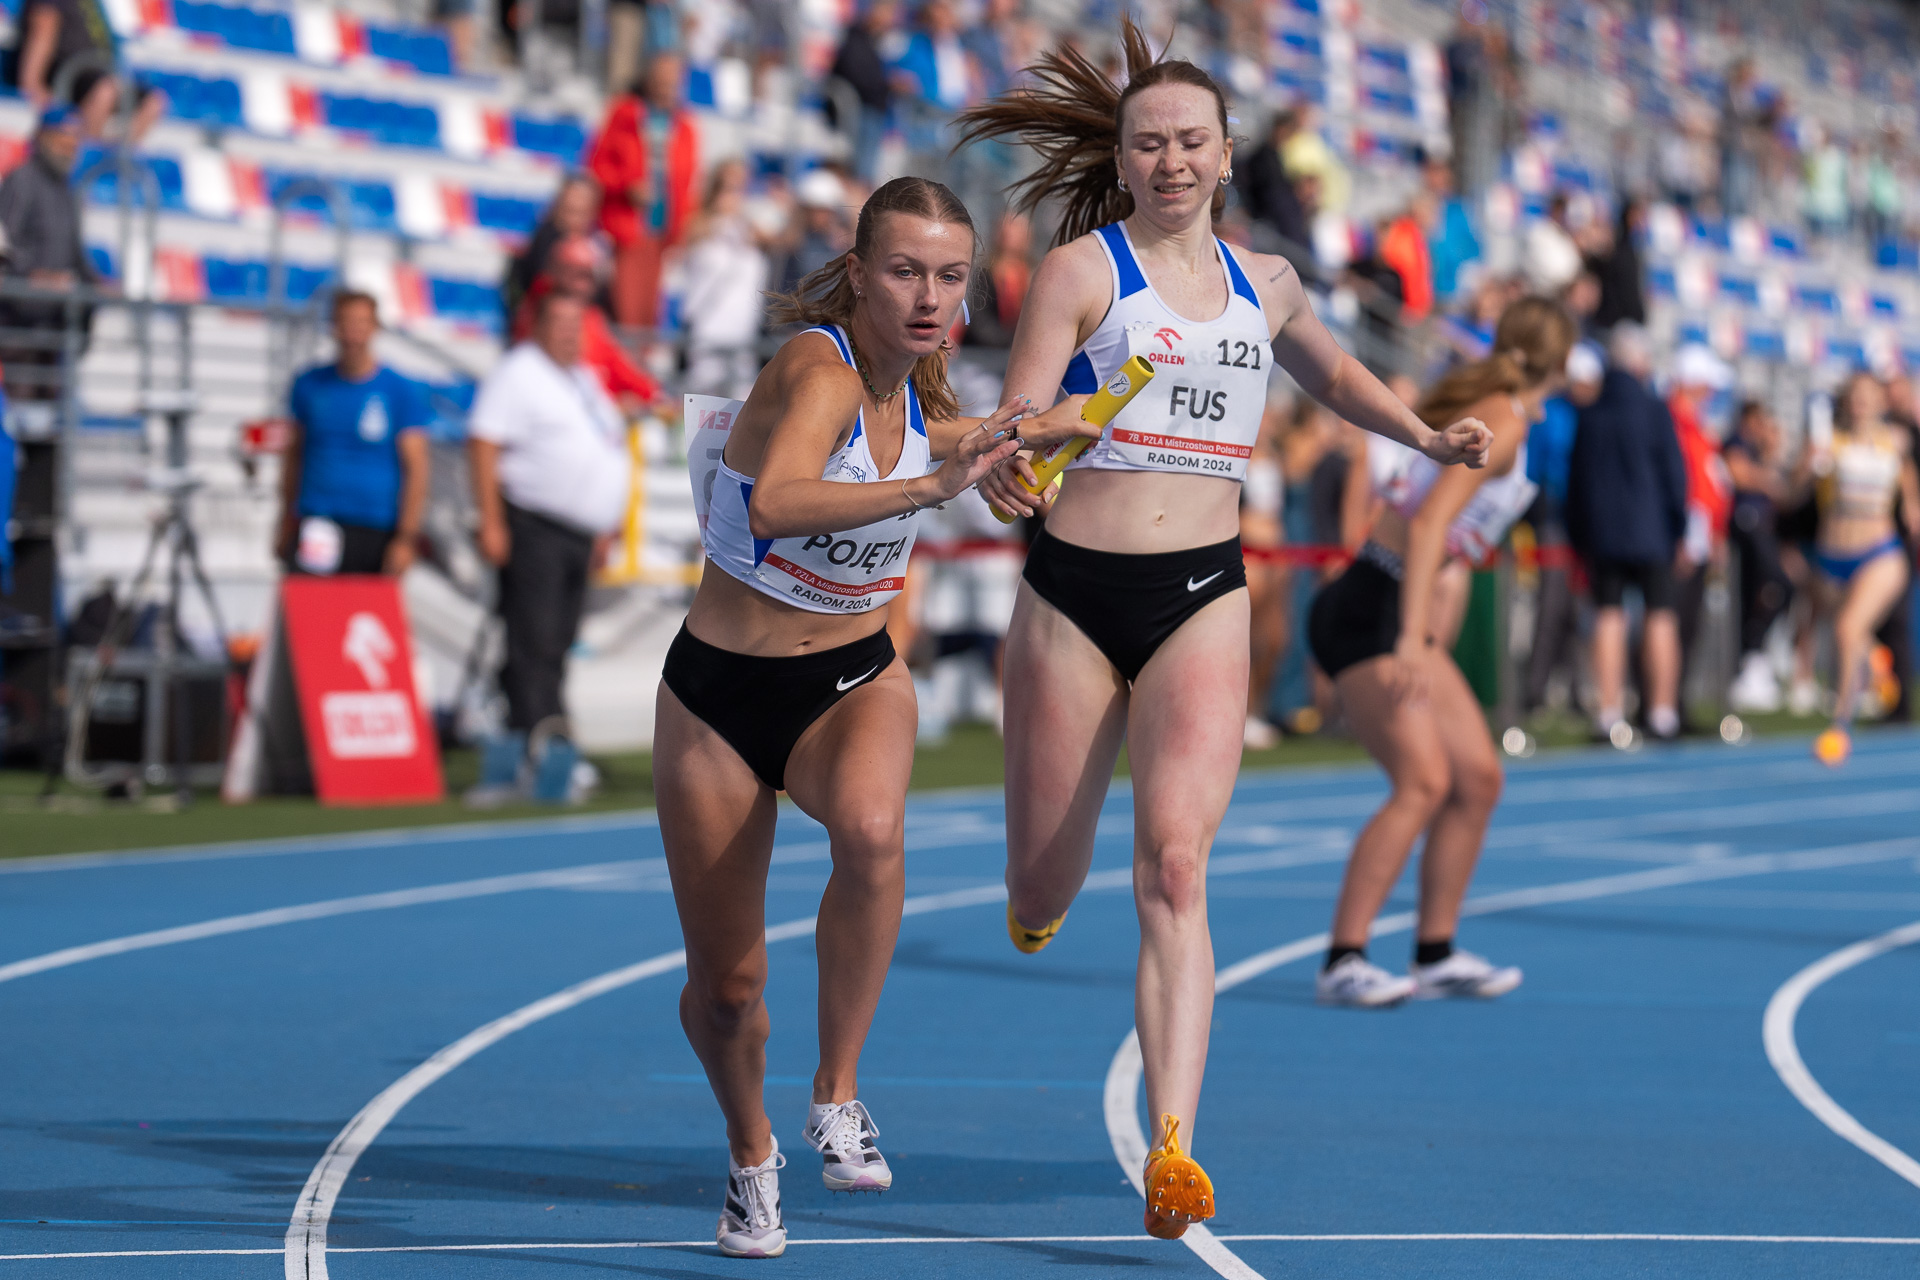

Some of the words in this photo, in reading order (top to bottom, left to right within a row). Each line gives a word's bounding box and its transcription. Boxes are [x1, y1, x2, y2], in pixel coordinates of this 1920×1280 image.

[1149, 352, 1185, 366] ORLEN
[1217, 338, 1260, 370] 121
[1169, 385, 1227, 421] FUS
[1128, 432, 1141, 443] 78.
[1143, 435, 1163, 446] PZLA
[1165, 438, 1214, 452] Mistrzostwa
[1215, 446, 1238, 455] Polski
[1239, 447, 1250, 457] U20
[1147, 452, 1199, 468] RADOM
[1202, 458, 1232, 472] 2024
[802, 534, 907, 574] POJĘTA
[779, 561, 793, 573] 78.
[794, 568, 815, 584] PZLA
[816, 580, 865, 595] Mistrzostwa
[864, 583, 879, 593] Polski
[879, 580, 894, 589] U20
[791, 584, 846, 609] RADOM
[845, 597, 871, 610] 2024
